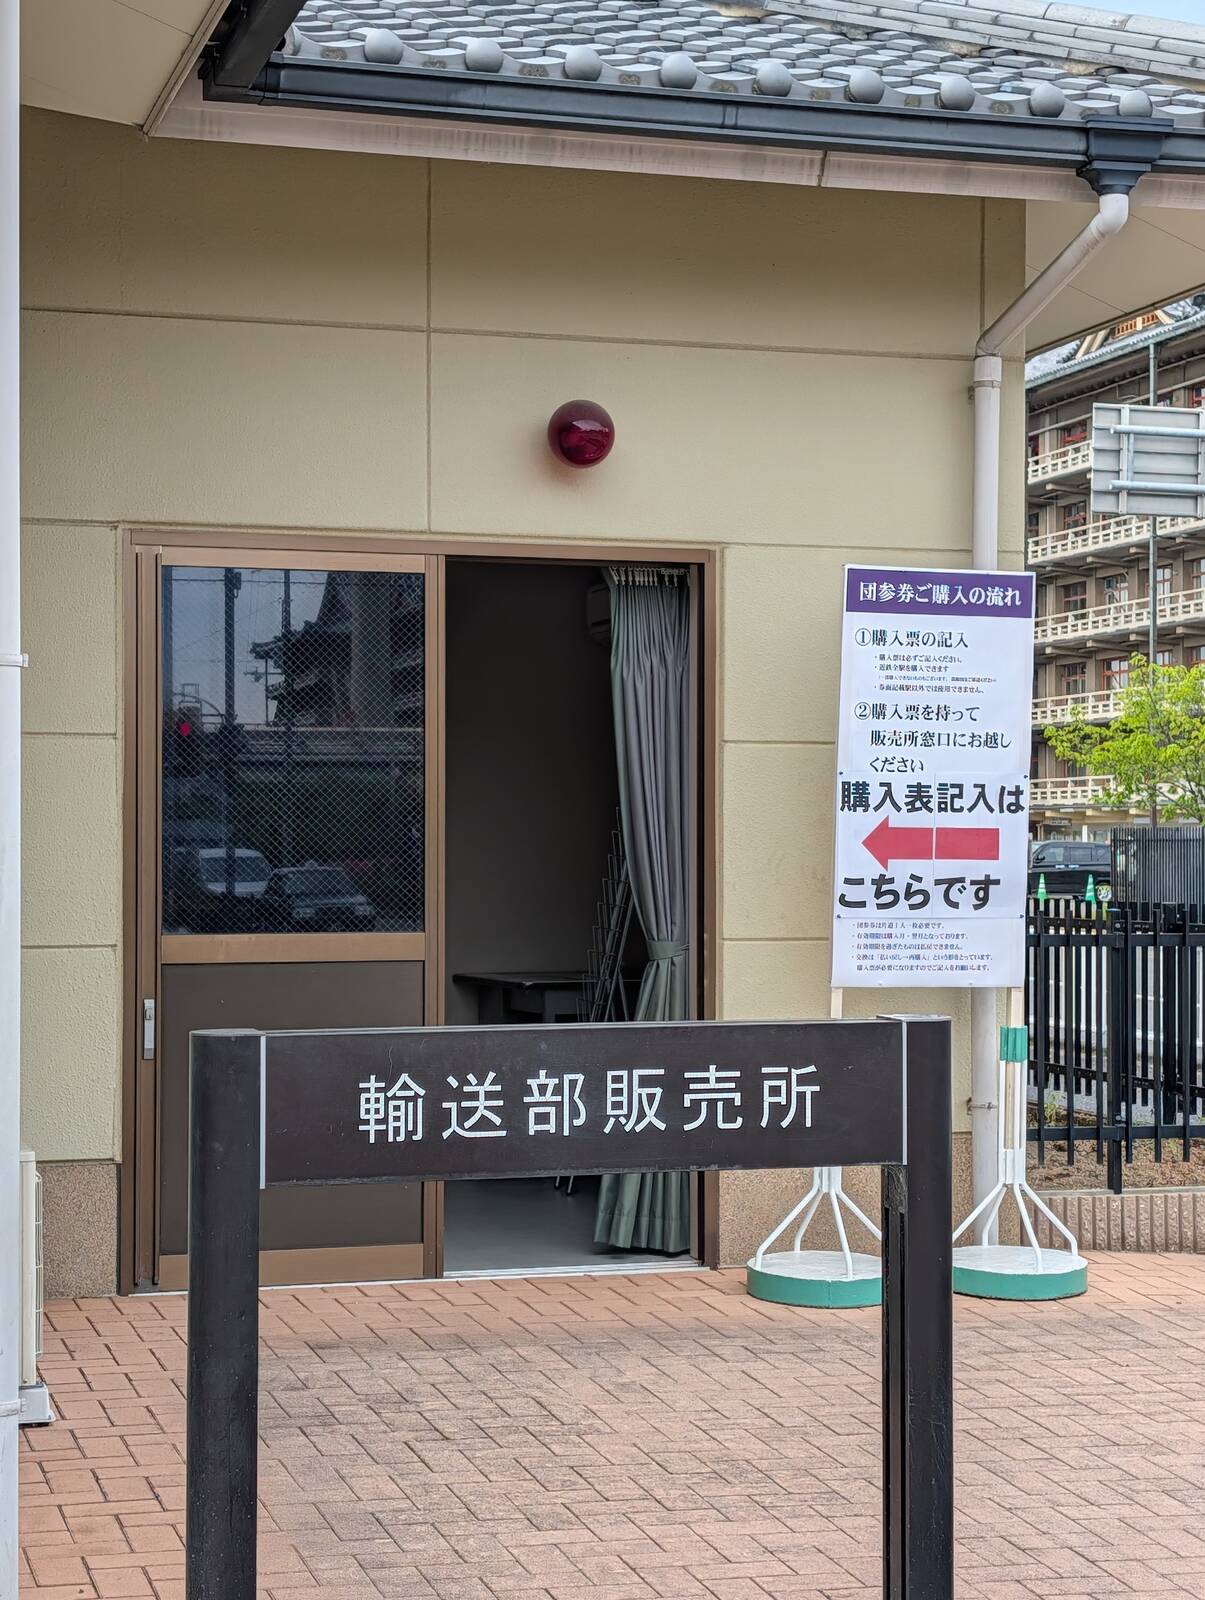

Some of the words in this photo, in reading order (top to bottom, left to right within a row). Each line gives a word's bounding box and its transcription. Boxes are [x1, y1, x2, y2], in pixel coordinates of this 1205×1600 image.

[859, 581, 1021, 607] 団参券ご購入の流れ
[854, 628, 969, 649] ①購入票の記入
[853, 702, 980, 722] ②購入票を持って
[870, 730, 1012, 749] 販売所窓口にお越し
[869, 757, 925, 773] ください
[840, 781, 1026, 814] 購入表記入は
[838, 873, 1001, 911] こちらです
[358, 1063, 822, 1144] 輸送部販売所
